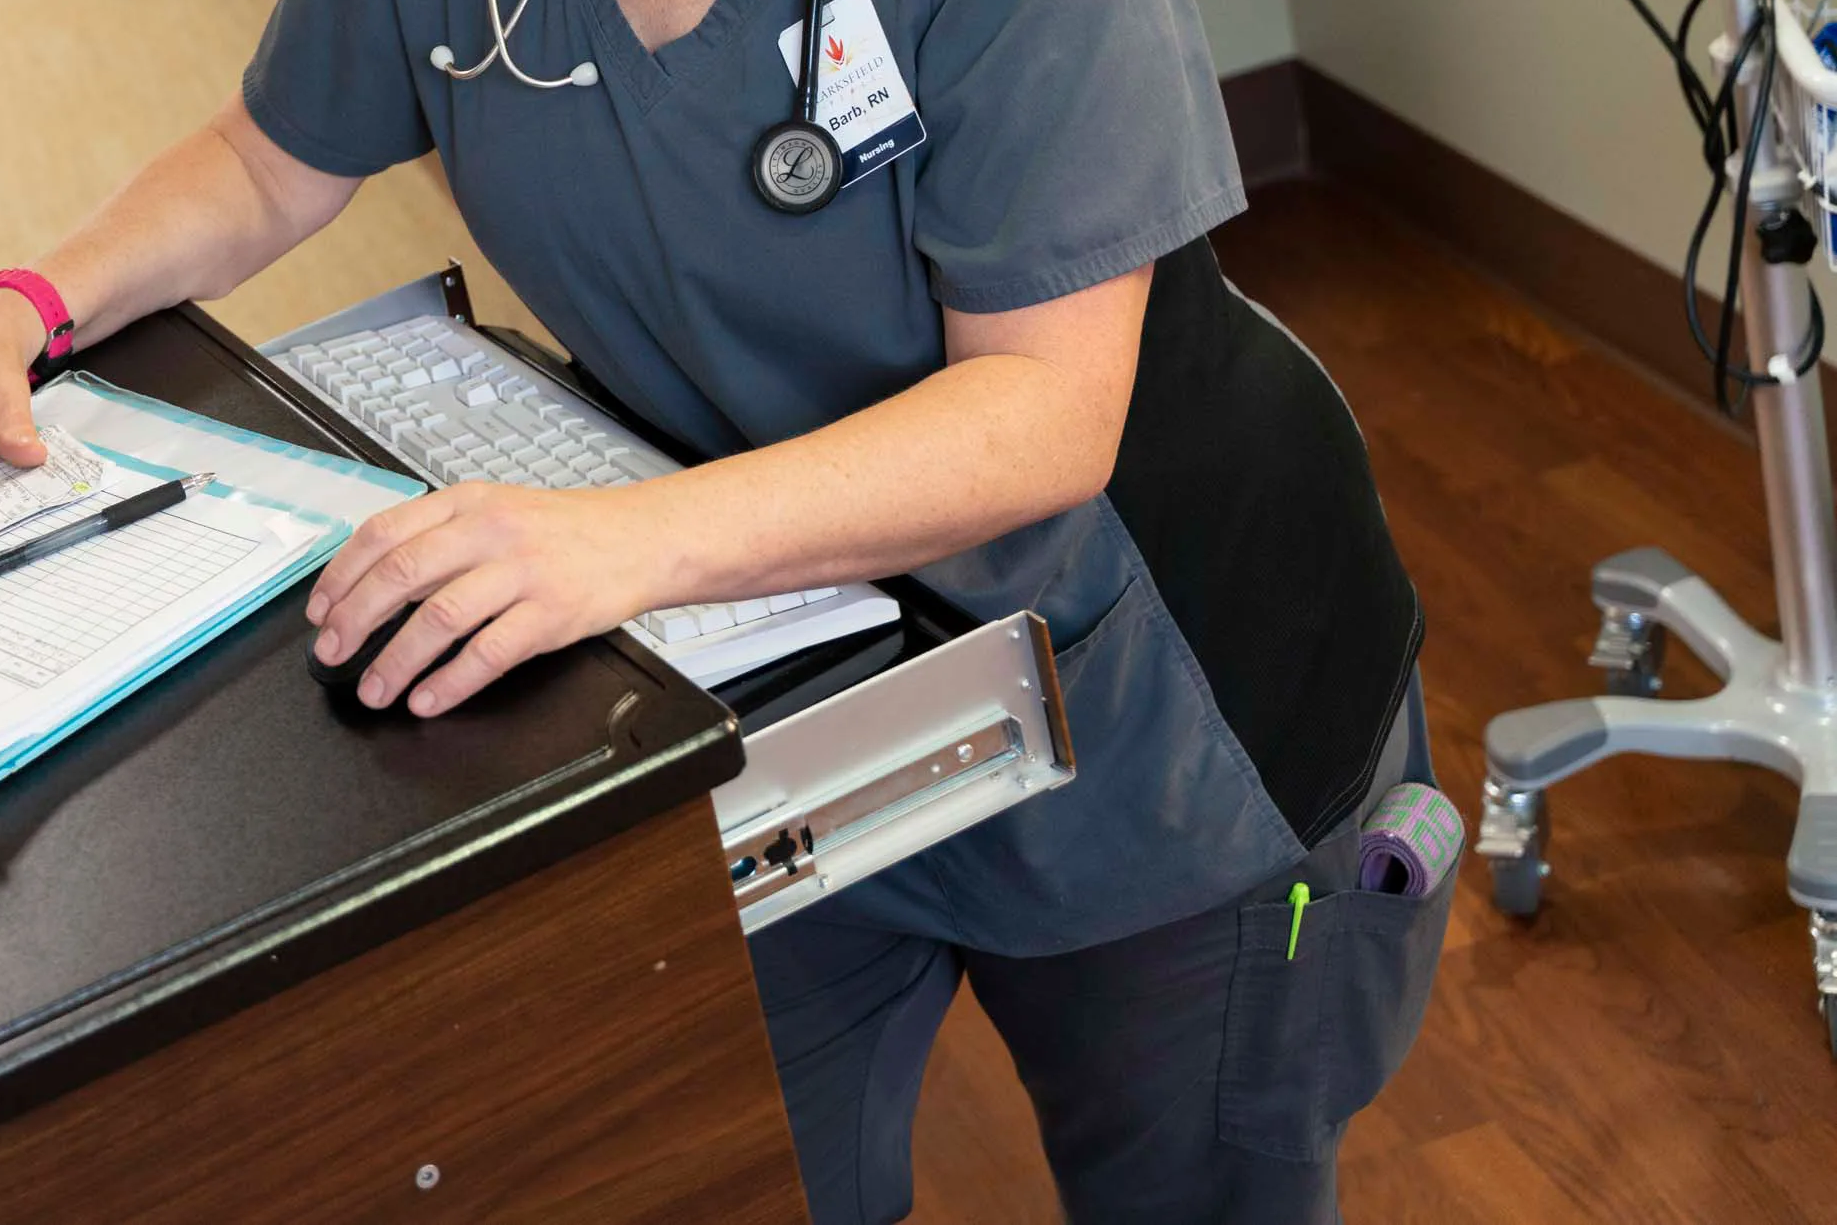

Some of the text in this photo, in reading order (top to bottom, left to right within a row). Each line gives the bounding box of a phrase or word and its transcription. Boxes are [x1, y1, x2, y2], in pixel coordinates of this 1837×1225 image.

[828, 105, 866, 131] Barb,
[867, 87, 889, 109] RN
[858, 137, 895, 163] Nursing
